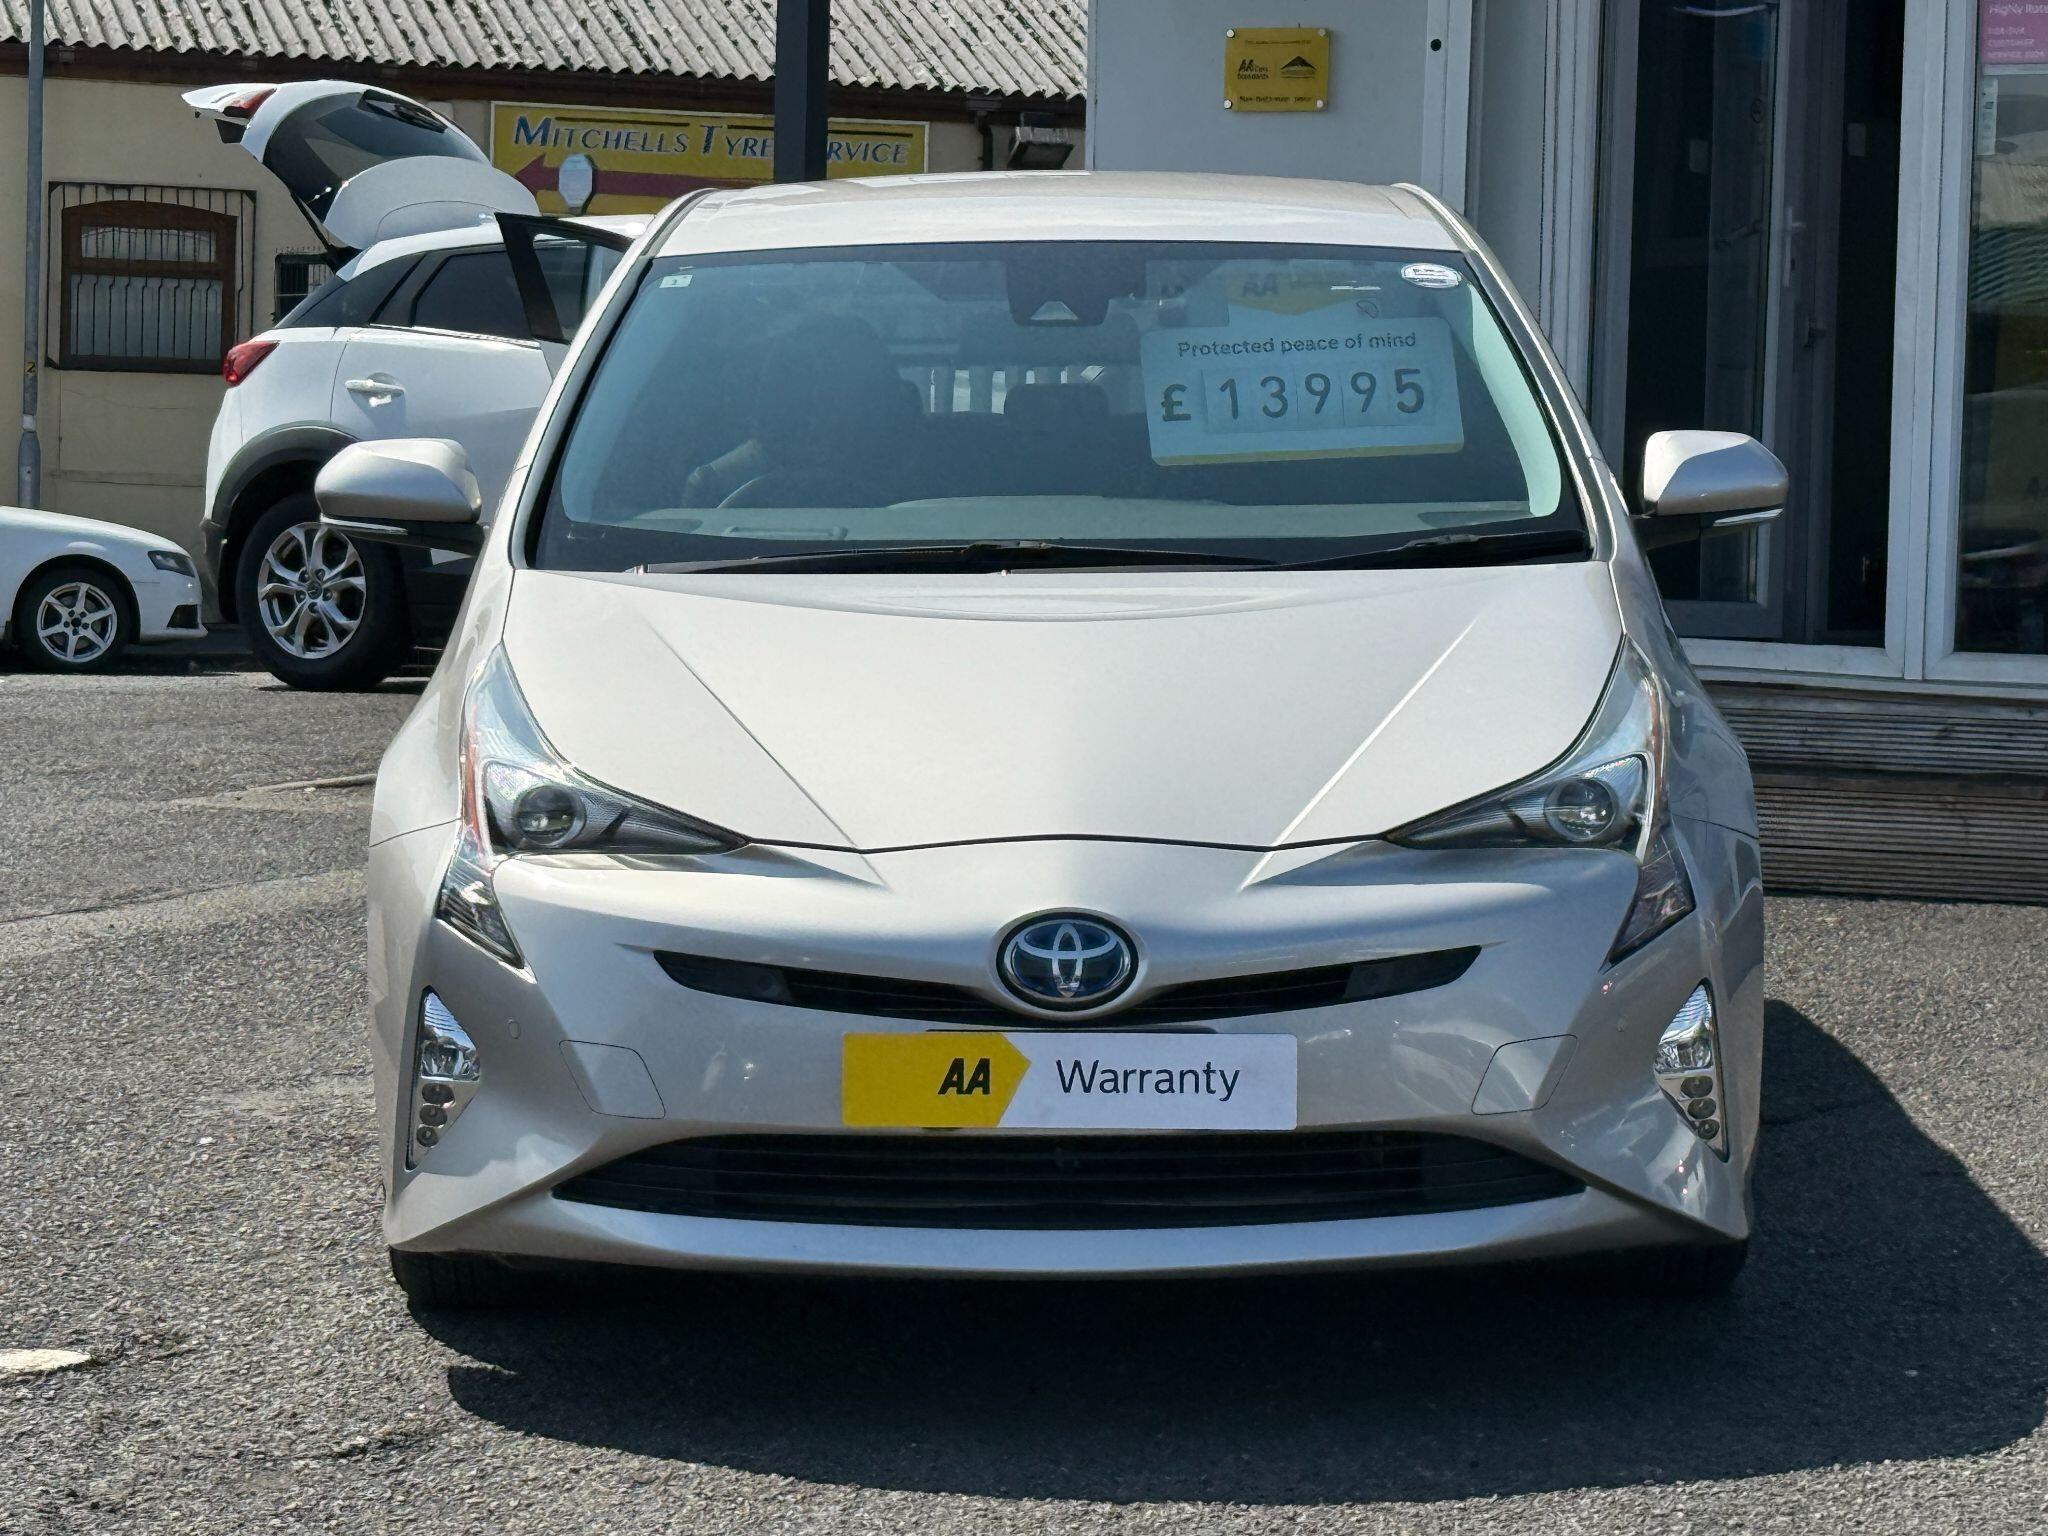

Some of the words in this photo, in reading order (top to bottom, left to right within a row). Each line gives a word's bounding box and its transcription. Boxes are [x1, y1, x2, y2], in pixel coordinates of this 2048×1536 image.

[826, 141, 908, 164] RVICE
[1178, 337, 1275, 357] Protected
[1281, 336, 1339, 355] peace
[1346, 333, 1363, 349] of
[1369, 332, 1417, 349] mind
[938, 1058, 991, 1095] AA
[1056, 1058, 1241, 1102] Warranty
